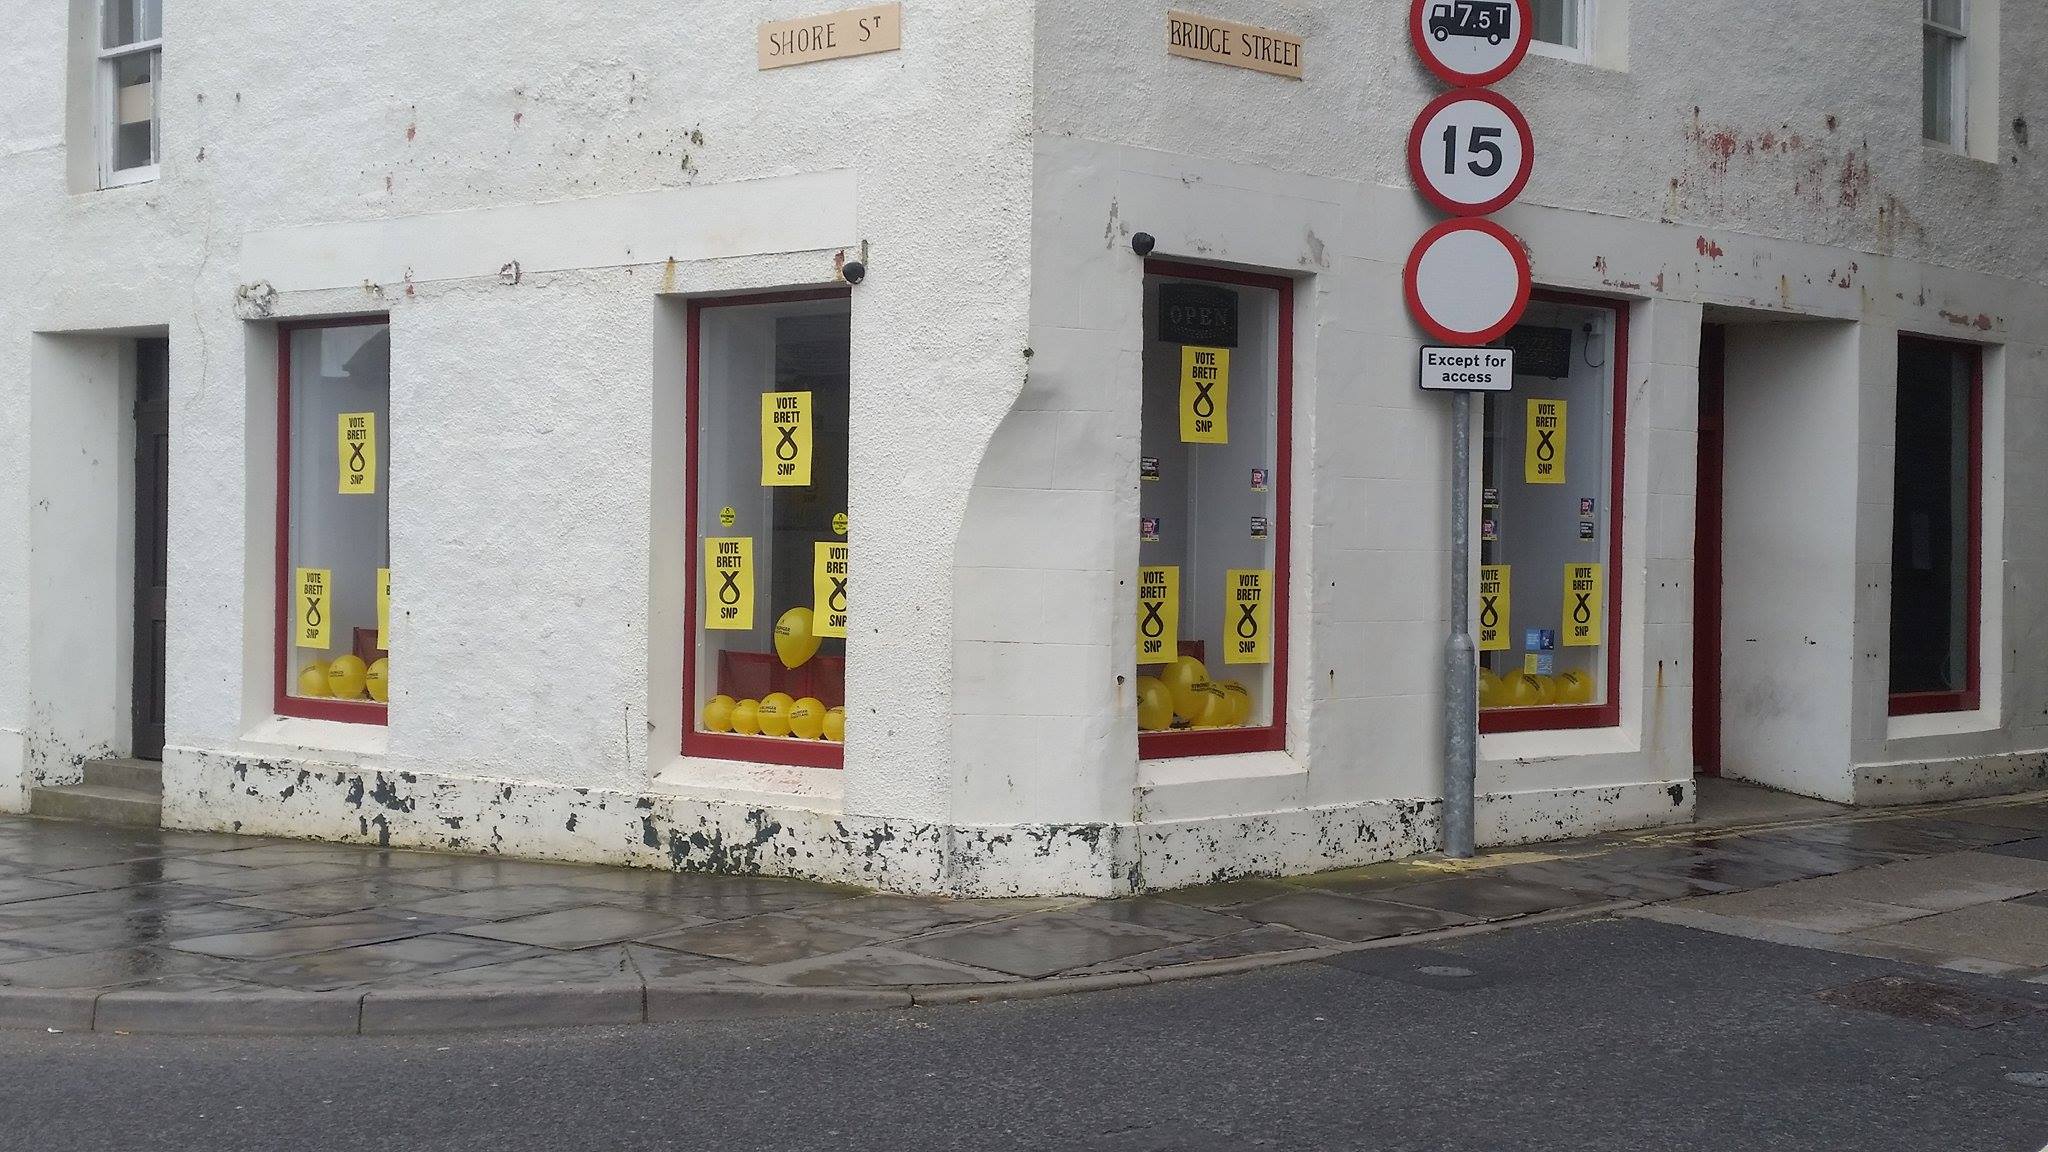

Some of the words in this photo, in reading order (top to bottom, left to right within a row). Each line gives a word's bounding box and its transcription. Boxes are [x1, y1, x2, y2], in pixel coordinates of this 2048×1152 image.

[770, 22, 837, 56] SHORE
[859, 15, 881, 42] ST
[1171, 19, 1231, 55] BRIDGE
[1241, 33, 1301, 67] STREET
[1442, 124, 1503, 177] 15
[1194, 352, 1215, 365] VOTE
[1428, 353, 1480, 369] Except
[1485, 354, 1507, 367] for
[1192, 366, 1218, 379] BRETT
[1442, 371, 1492, 383] access
[776, 397, 798, 409] VOTE
[1538, 403, 1556, 415] VOTE
[348, 417, 365, 428] VOTE
[773, 411, 801, 423] BRETT
[1535, 416, 1558, 428] BRETT
[1195, 420, 1213, 432] SNP
[346, 429, 367, 440] BRETT
[777, 464, 796, 476] SNP
[1537, 463, 1553, 475] SNP
[350, 474, 364, 485] SNP
[718, 542, 739, 554] VOTE
[716, 556, 742, 568] BRETT
[306, 572, 321, 583] VOTE
[1143, 571, 1165, 584] VOTE
[1480, 569, 1499, 581] VOTE
[1574, 567, 1592, 578] VOTE
[1239, 574, 1260, 587] VOTE
[1572, 579, 1594, 591] BRETT
[303, 584, 323, 595] BRETT
[1140, 586, 1167, 599] BRETT
[1236, 588, 1262, 601] BRETT
[720, 607, 738, 619] SNP
[306, 628, 319, 639] SNP
[1481, 629, 1497, 641] SNP
[1574, 625, 1589, 637] SNP
[1143, 640, 1162, 653] SNP
[1238, 641, 1256, 653] SNP
